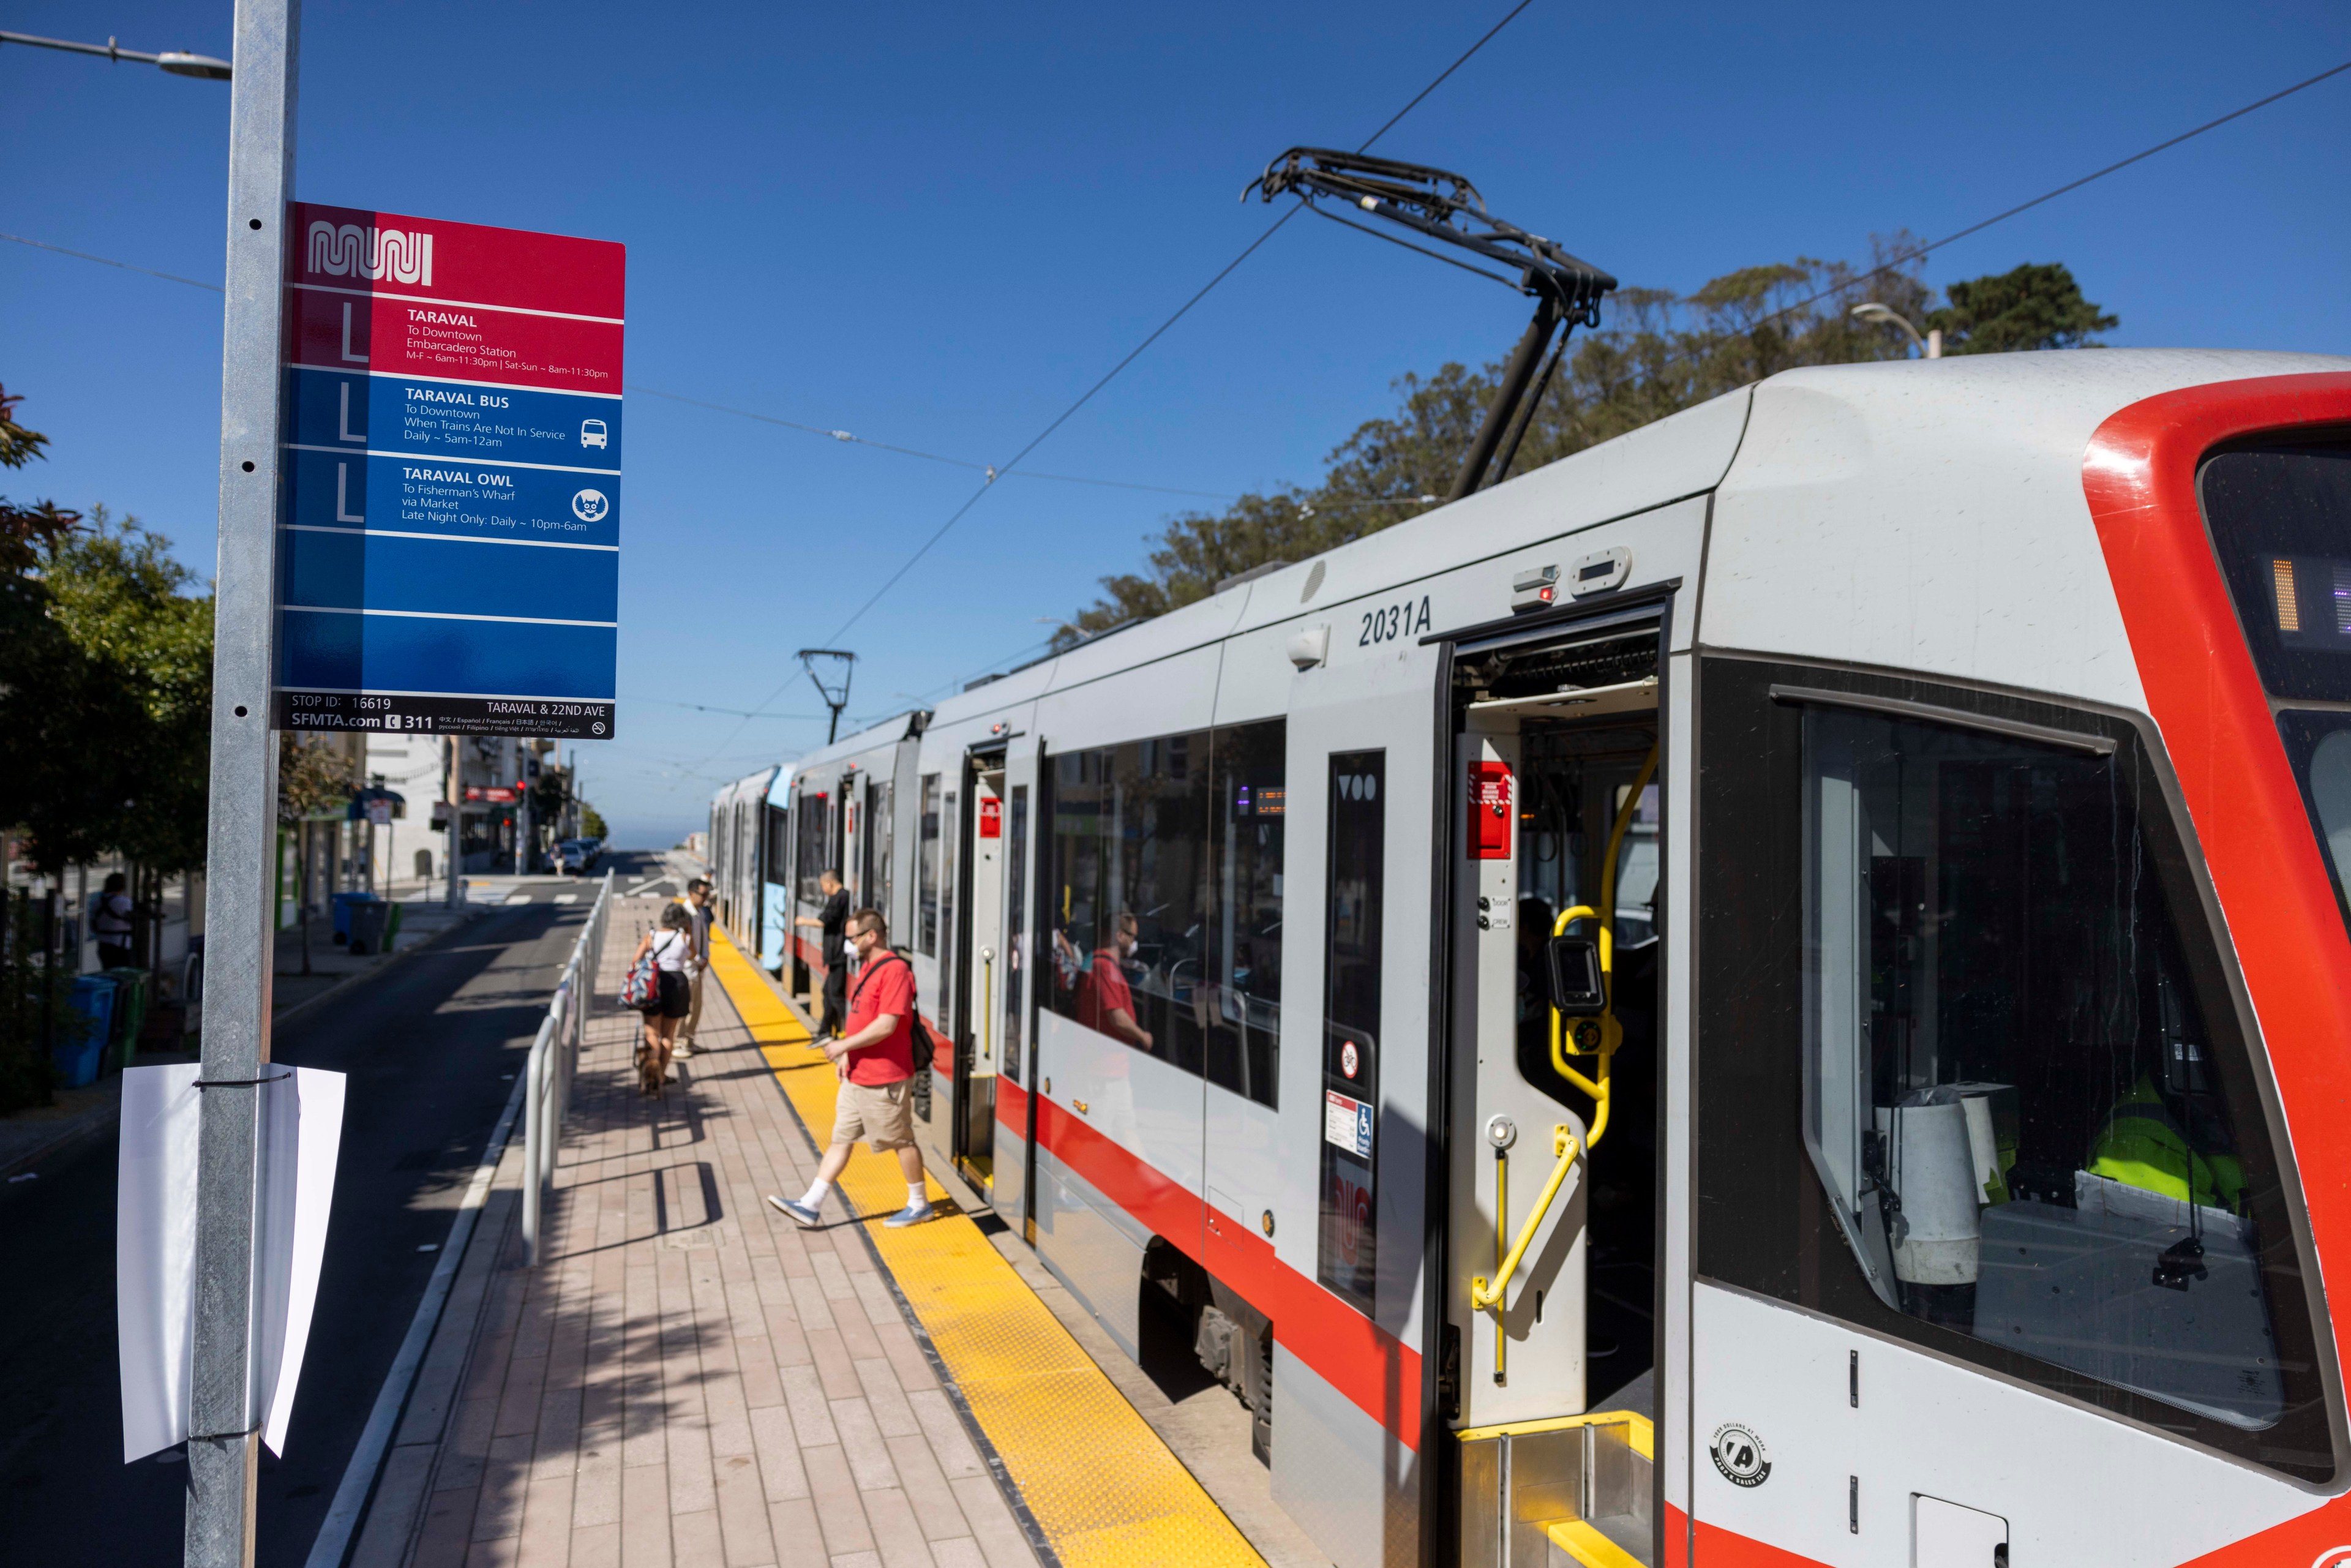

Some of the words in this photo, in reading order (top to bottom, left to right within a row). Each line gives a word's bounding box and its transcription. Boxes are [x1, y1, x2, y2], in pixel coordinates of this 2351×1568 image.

[307, 221, 433, 287] MUNI
[407, 309, 477, 329] TARAVAL
[342, 302, 369, 362] L
[407, 325, 419, 334] To
[423, 326, 481, 342] Downtown
[407, 338, 476, 356] Embarcadero
[480, 346, 516, 358] Station
[436, 353, 498, 367] 6am-11:30pm
[500, 360, 502, 370] |
[505, 361, 537, 370] Sat-Sun
[549, 366, 607, 378] 8am-11:30pm
[405, 388, 474, 406] TARAVAL
[481, 396, 509, 408] BUS
[340, 382, 366, 442] L
[405, 404, 416, 413] To
[421, 405, 479, 419] Downtown
[405, 417, 436, 428] When
[441, 421, 470, 431] Trains
[473, 424, 491, 433] Are
[496, 426, 514, 435] Not
[518, 427, 526, 436] In
[531, 429, 565, 439] Service
[405, 430, 430, 443] Daily
[445, 433, 503, 446] 5am-12am
[403, 468, 473, 486] TARAVAL
[478, 474, 513, 487] OWL
[337, 463, 364, 523] L
[403, 484, 414, 493] To
[419, 485, 479, 500] Fisherman's
[482, 490, 515, 500] Wharf
[421, 498, 458, 509] Market
[402, 510, 424, 520] Late
[429, 512, 456, 523] Night
[461, 514, 487, 526] Only:
[492, 516, 516, 528] Daily
[531, 519, 587, 531] 10pm-6am
[1359, 595, 1431, 647] 2031A
[293, 696, 321, 706] STOP
[326, 697, 340, 707] ID:
[353, 697, 391, 710] 16619
[487, 702, 536, 713] TARAVAL
[541, 705, 547, 714] &
[552, 705, 581, 715] 22ND
[584, 706, 604, 716] AVE
[293, 713, 380, 727] SFMTA.com
[405, 716, 431, 728] 311
[1714, 1427, 1722, 1438] YOUR
[1755, 1435, 1766, 1452] WORK
[1714, 1457, 1728, 1474] PROP
[1756, 1470, 1767, 1482] TAX
